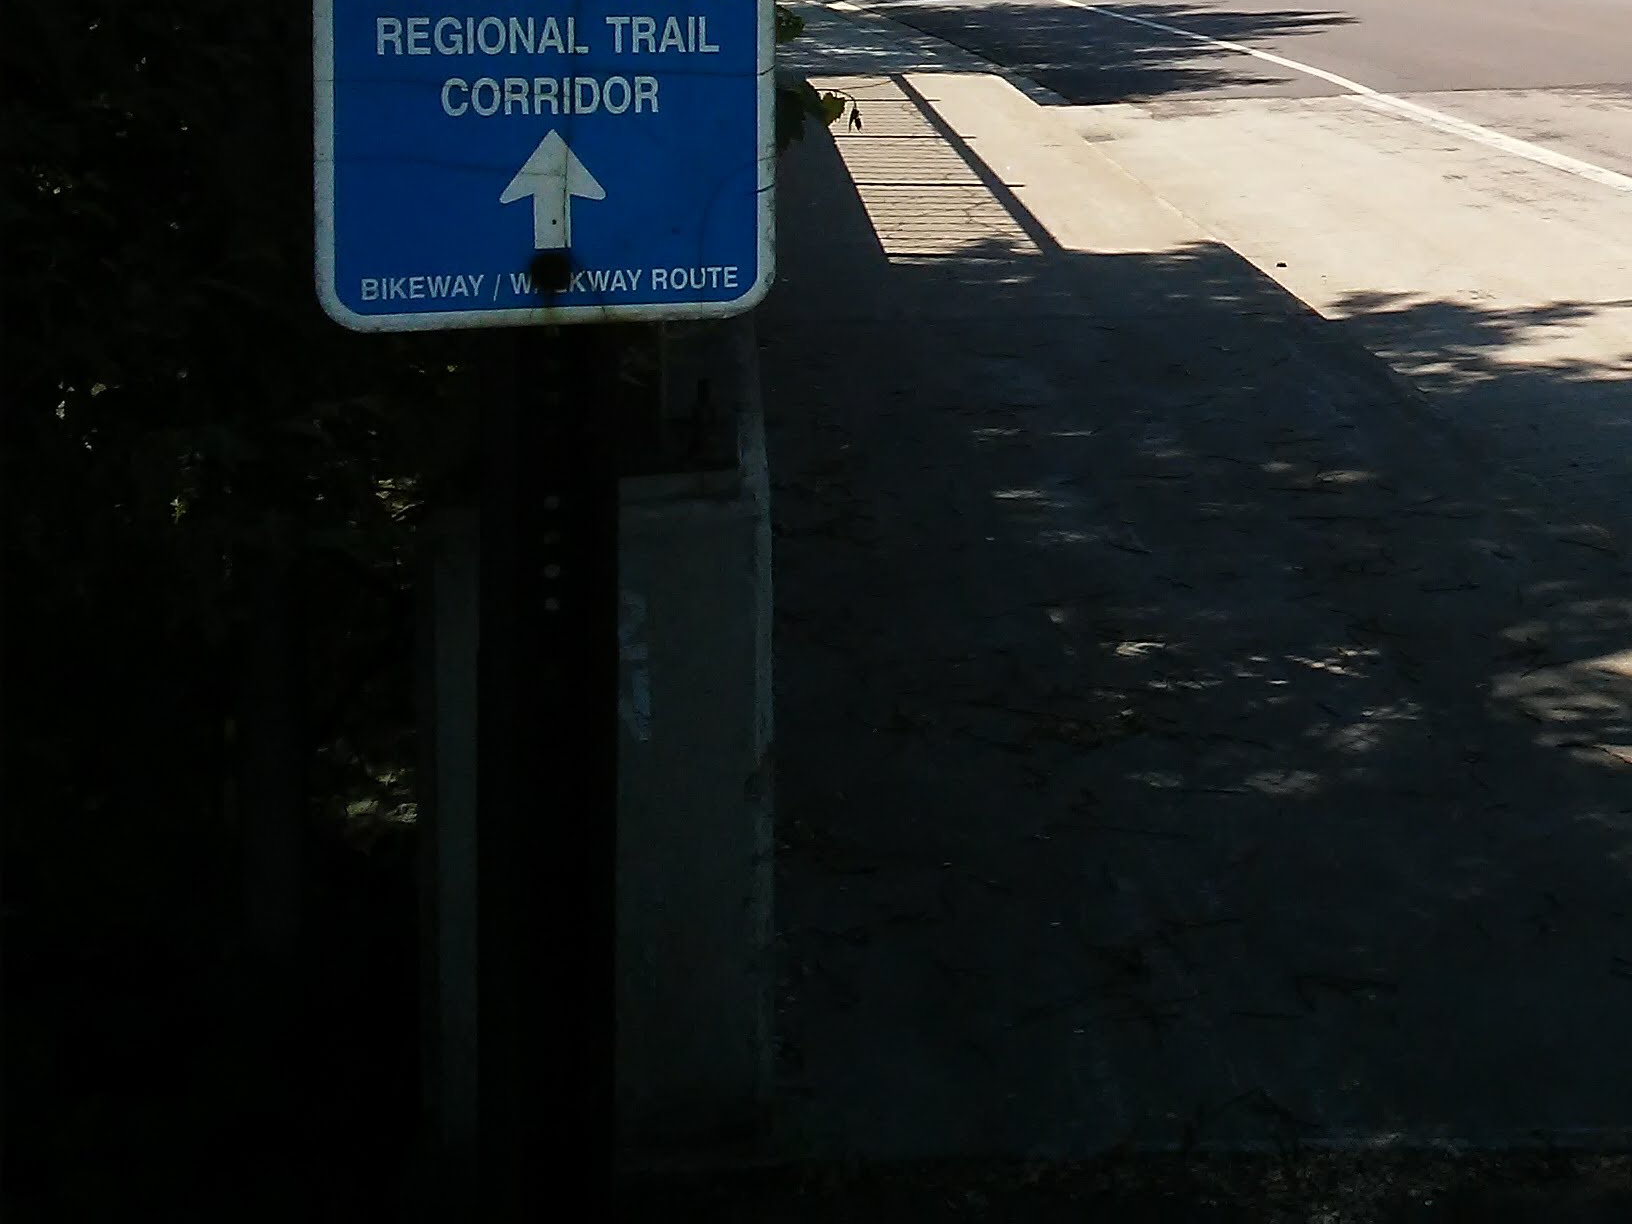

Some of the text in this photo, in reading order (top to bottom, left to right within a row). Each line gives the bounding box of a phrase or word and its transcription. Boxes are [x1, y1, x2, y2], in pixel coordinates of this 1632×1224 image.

[375, 15, 720, 56] REGIONAL TRAIL
[440, 76, 660, 117] CORRIDOR
[360, 273, 484, 302] BIKEWAY
[510, 268, 642, 296] WKWAY
[651, 265, 739, 291] ROUTE
